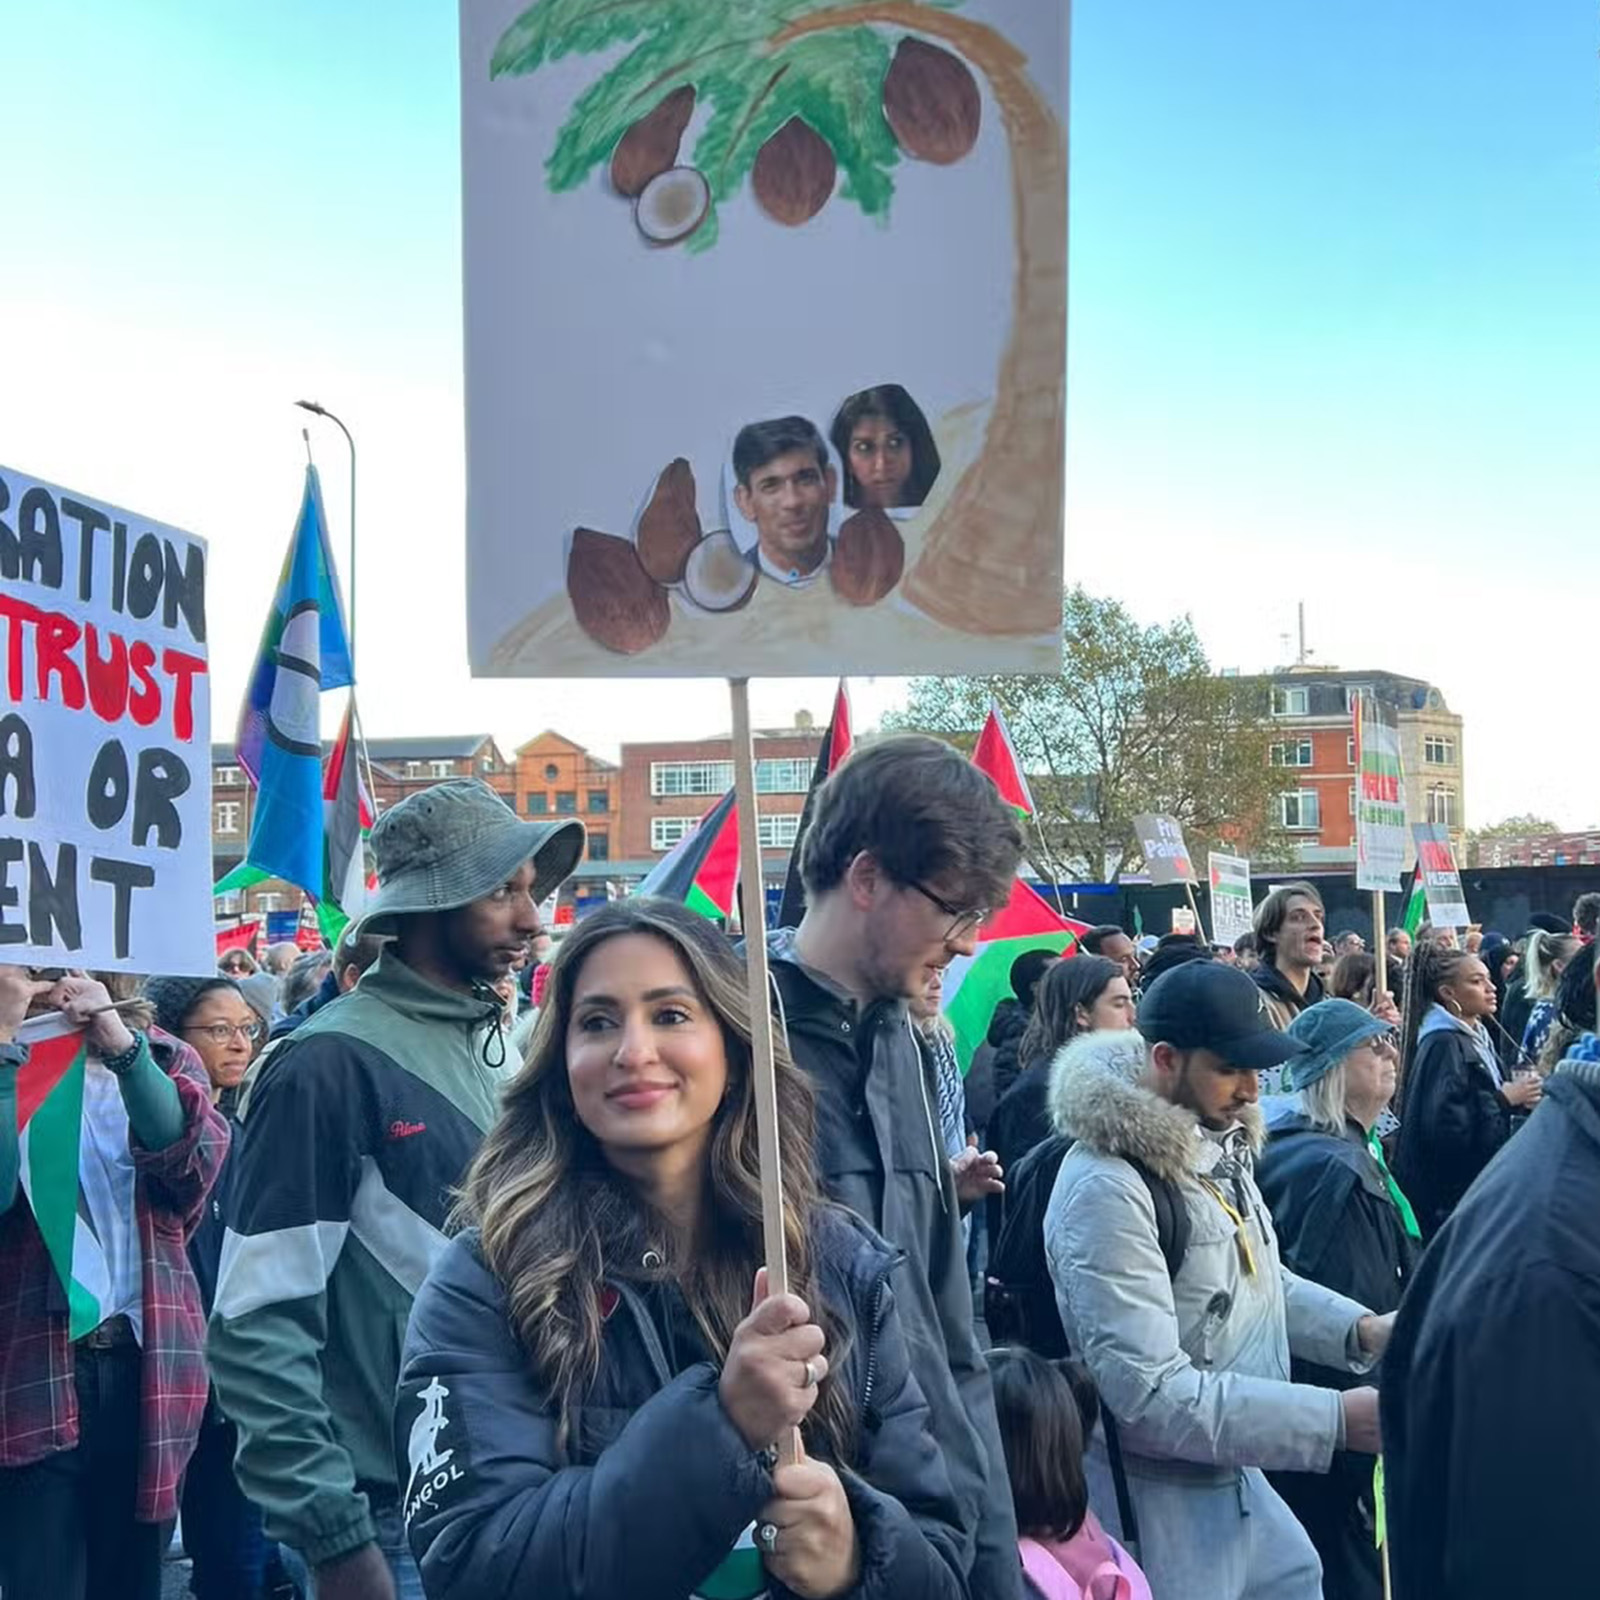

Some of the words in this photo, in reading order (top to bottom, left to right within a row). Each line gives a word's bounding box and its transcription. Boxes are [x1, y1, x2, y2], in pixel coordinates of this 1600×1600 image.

[0, 593, 208, 743] TRUST
[87, 738, 191, 849] OR
[0, 836, 155, 959] ENT
[1213, 893, 1251, 919] FREE
[404, 1464, 465, 1524] NGOL
